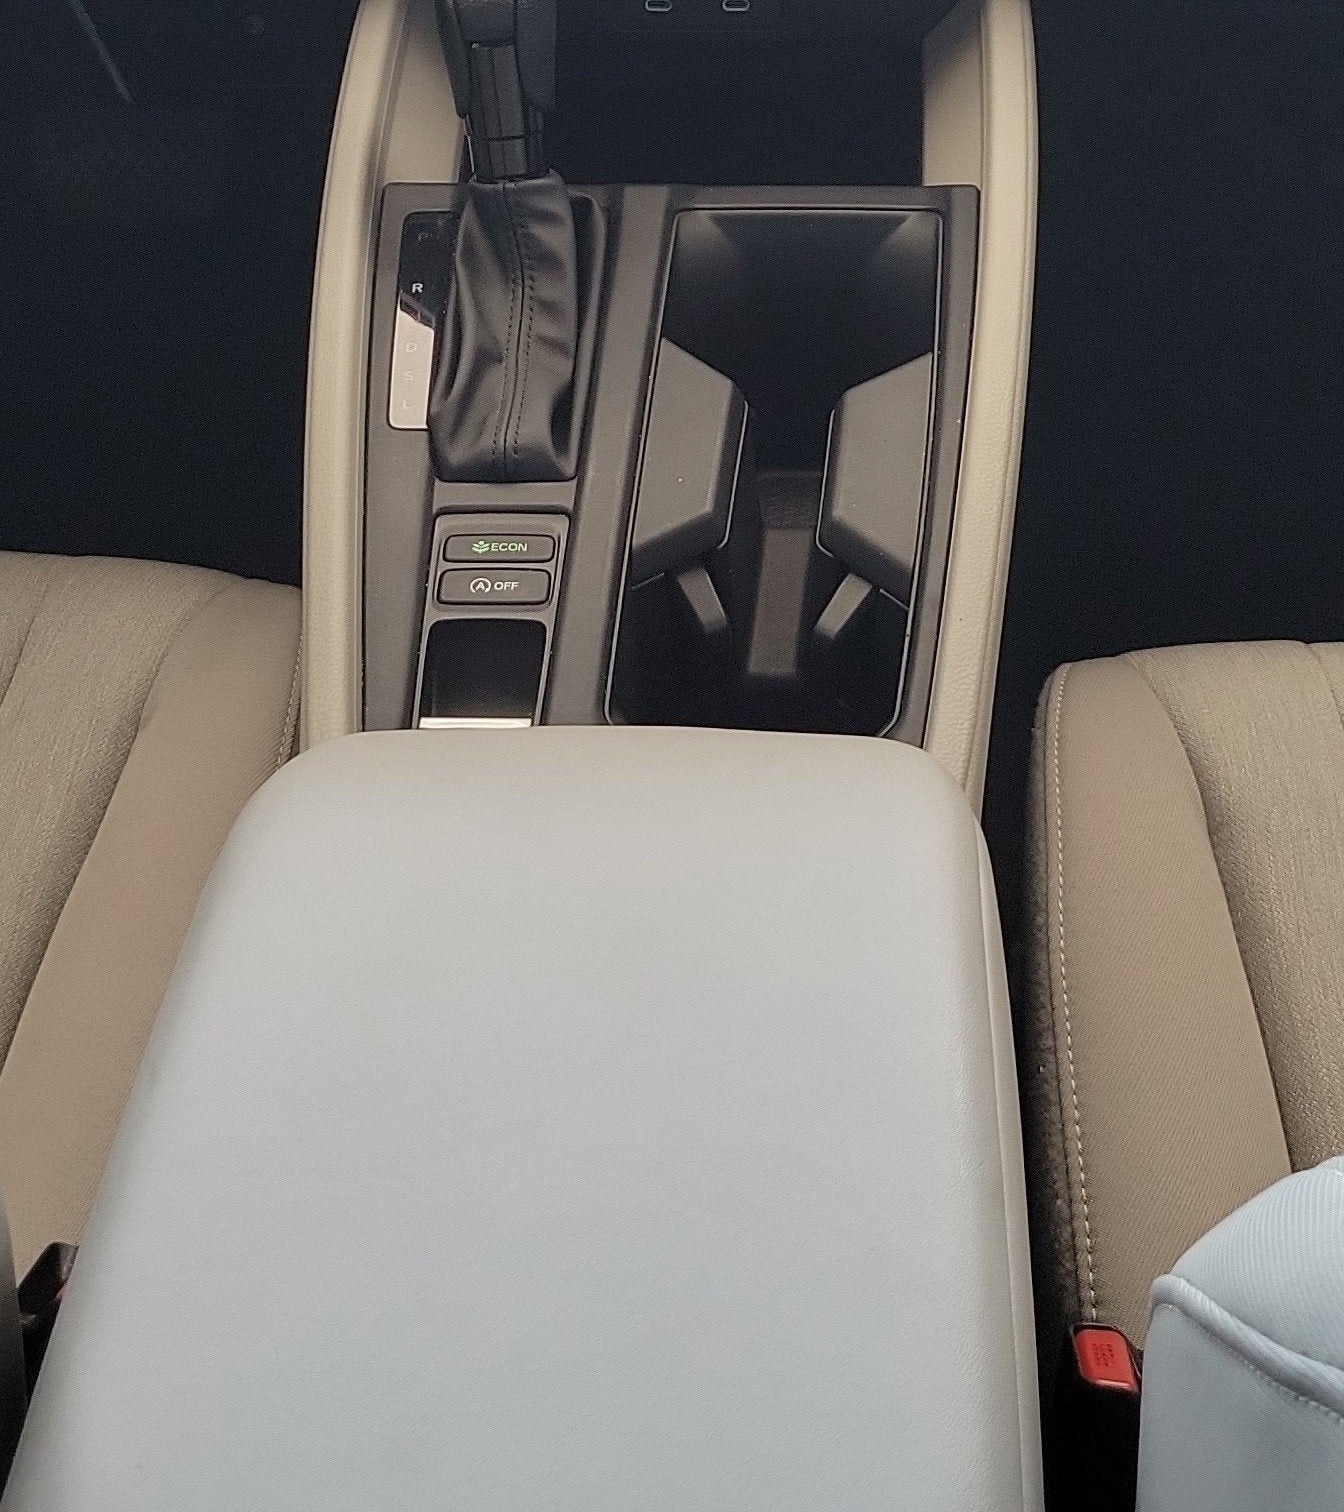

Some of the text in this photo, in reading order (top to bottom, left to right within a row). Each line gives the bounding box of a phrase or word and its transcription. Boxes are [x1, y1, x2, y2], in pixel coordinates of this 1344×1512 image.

[411, 282, 424, 294] R
[490, 542, 528, 552] ECON
[493, 581, 519, 591] OFF
